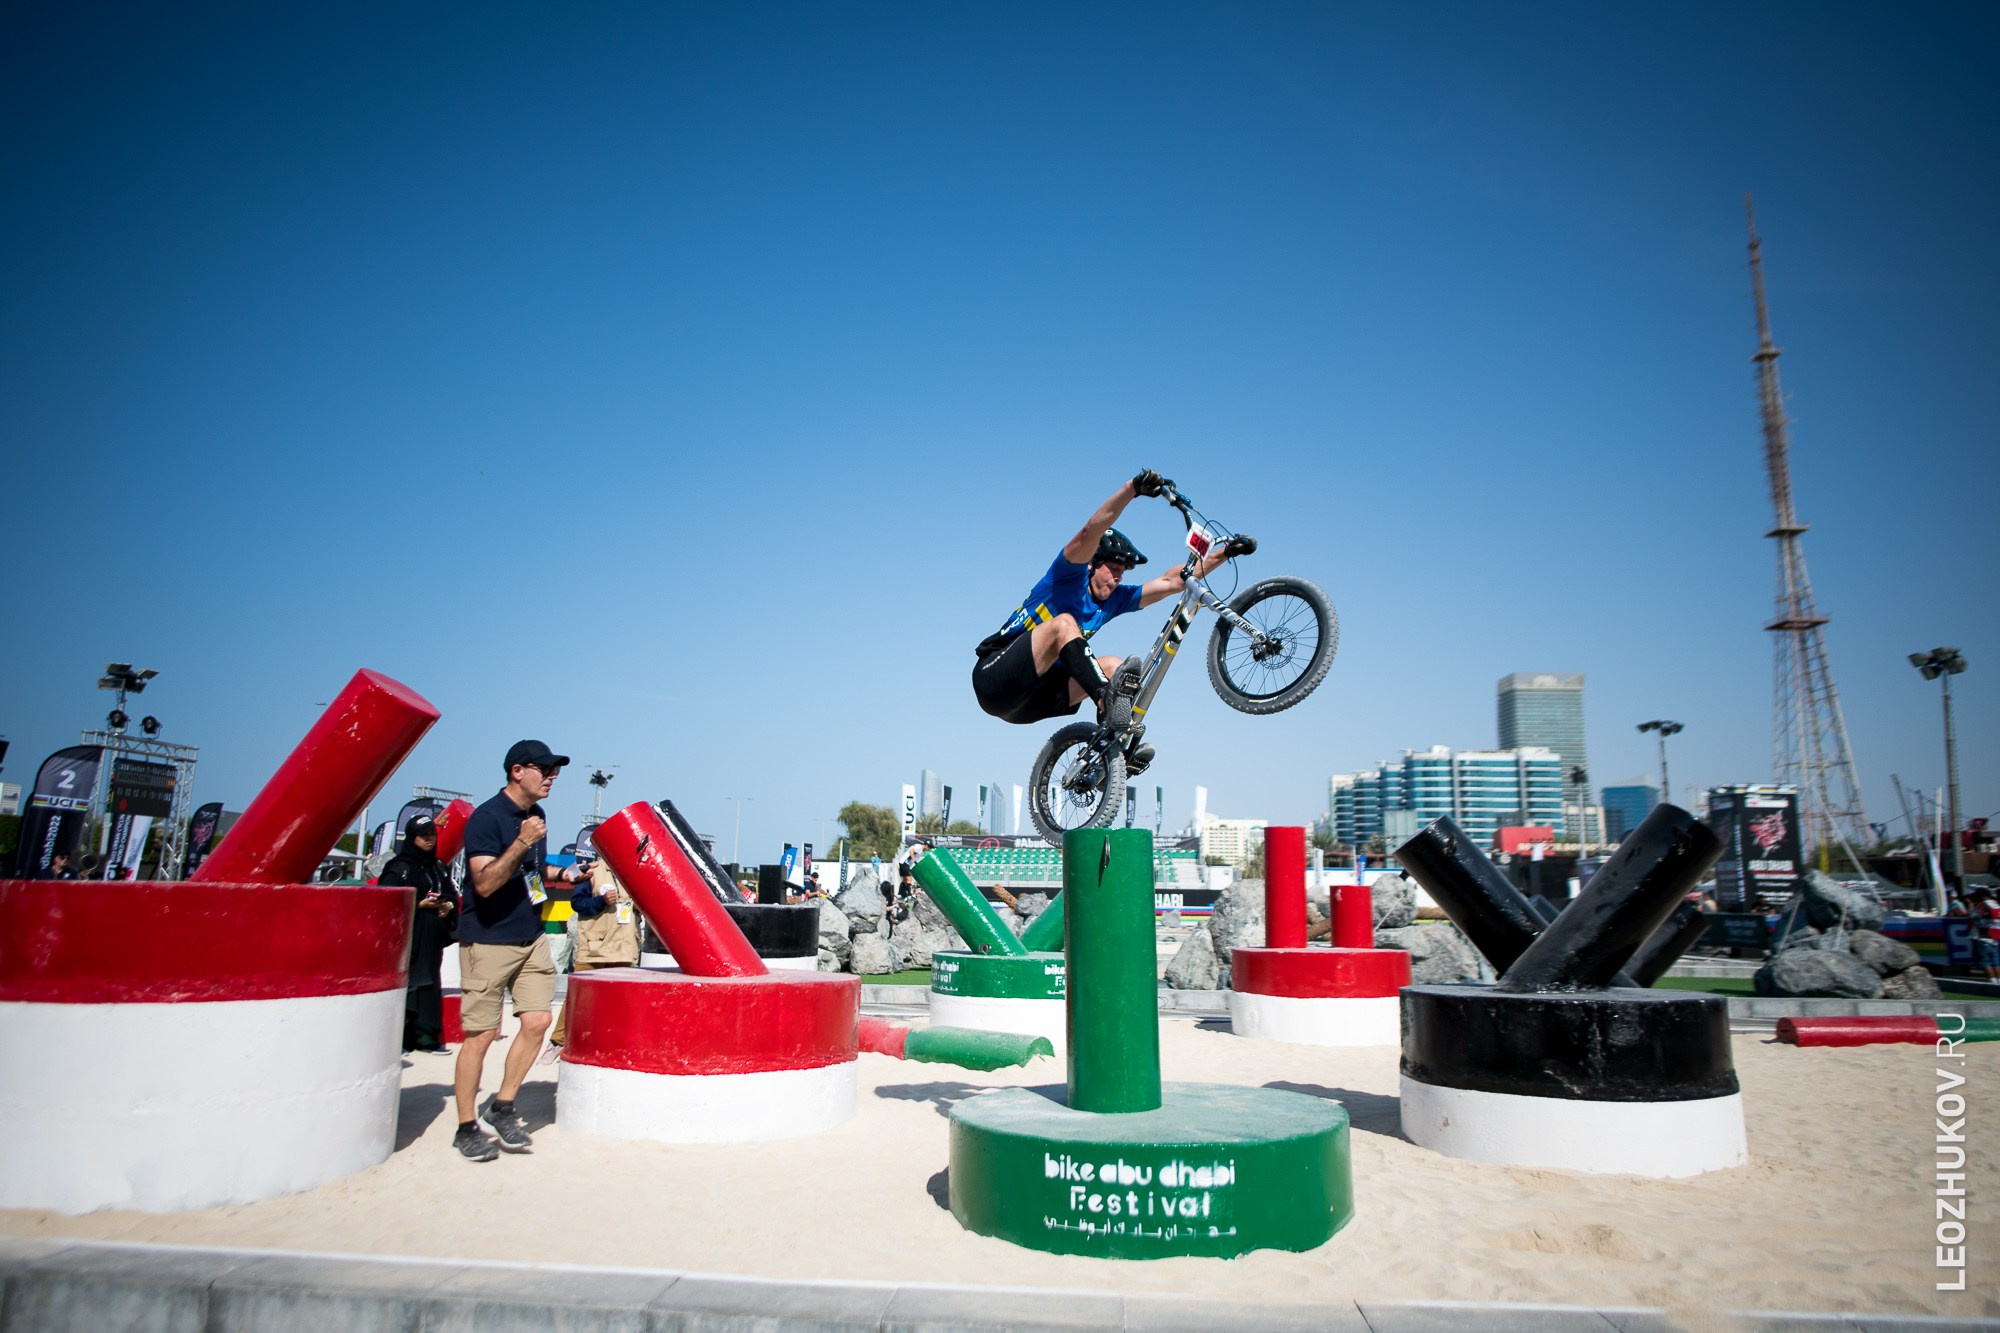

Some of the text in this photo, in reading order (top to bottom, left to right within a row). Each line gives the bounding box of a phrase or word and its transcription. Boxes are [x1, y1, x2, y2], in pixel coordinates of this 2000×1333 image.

[1234, 618, 1257, 635] JITSIE
[57, 769, 76, 789] 2
[48, 797, 74, 808] UCI
[905, 795, 915, 824] UCI
[41, 815, 62, 869] dhabi2022
[1154, 893, 1183, 907] HABI
[1044, 1152, 1236, 1188] bike abu dhabi
[1070, 1185, 1212, 1218] Festival
